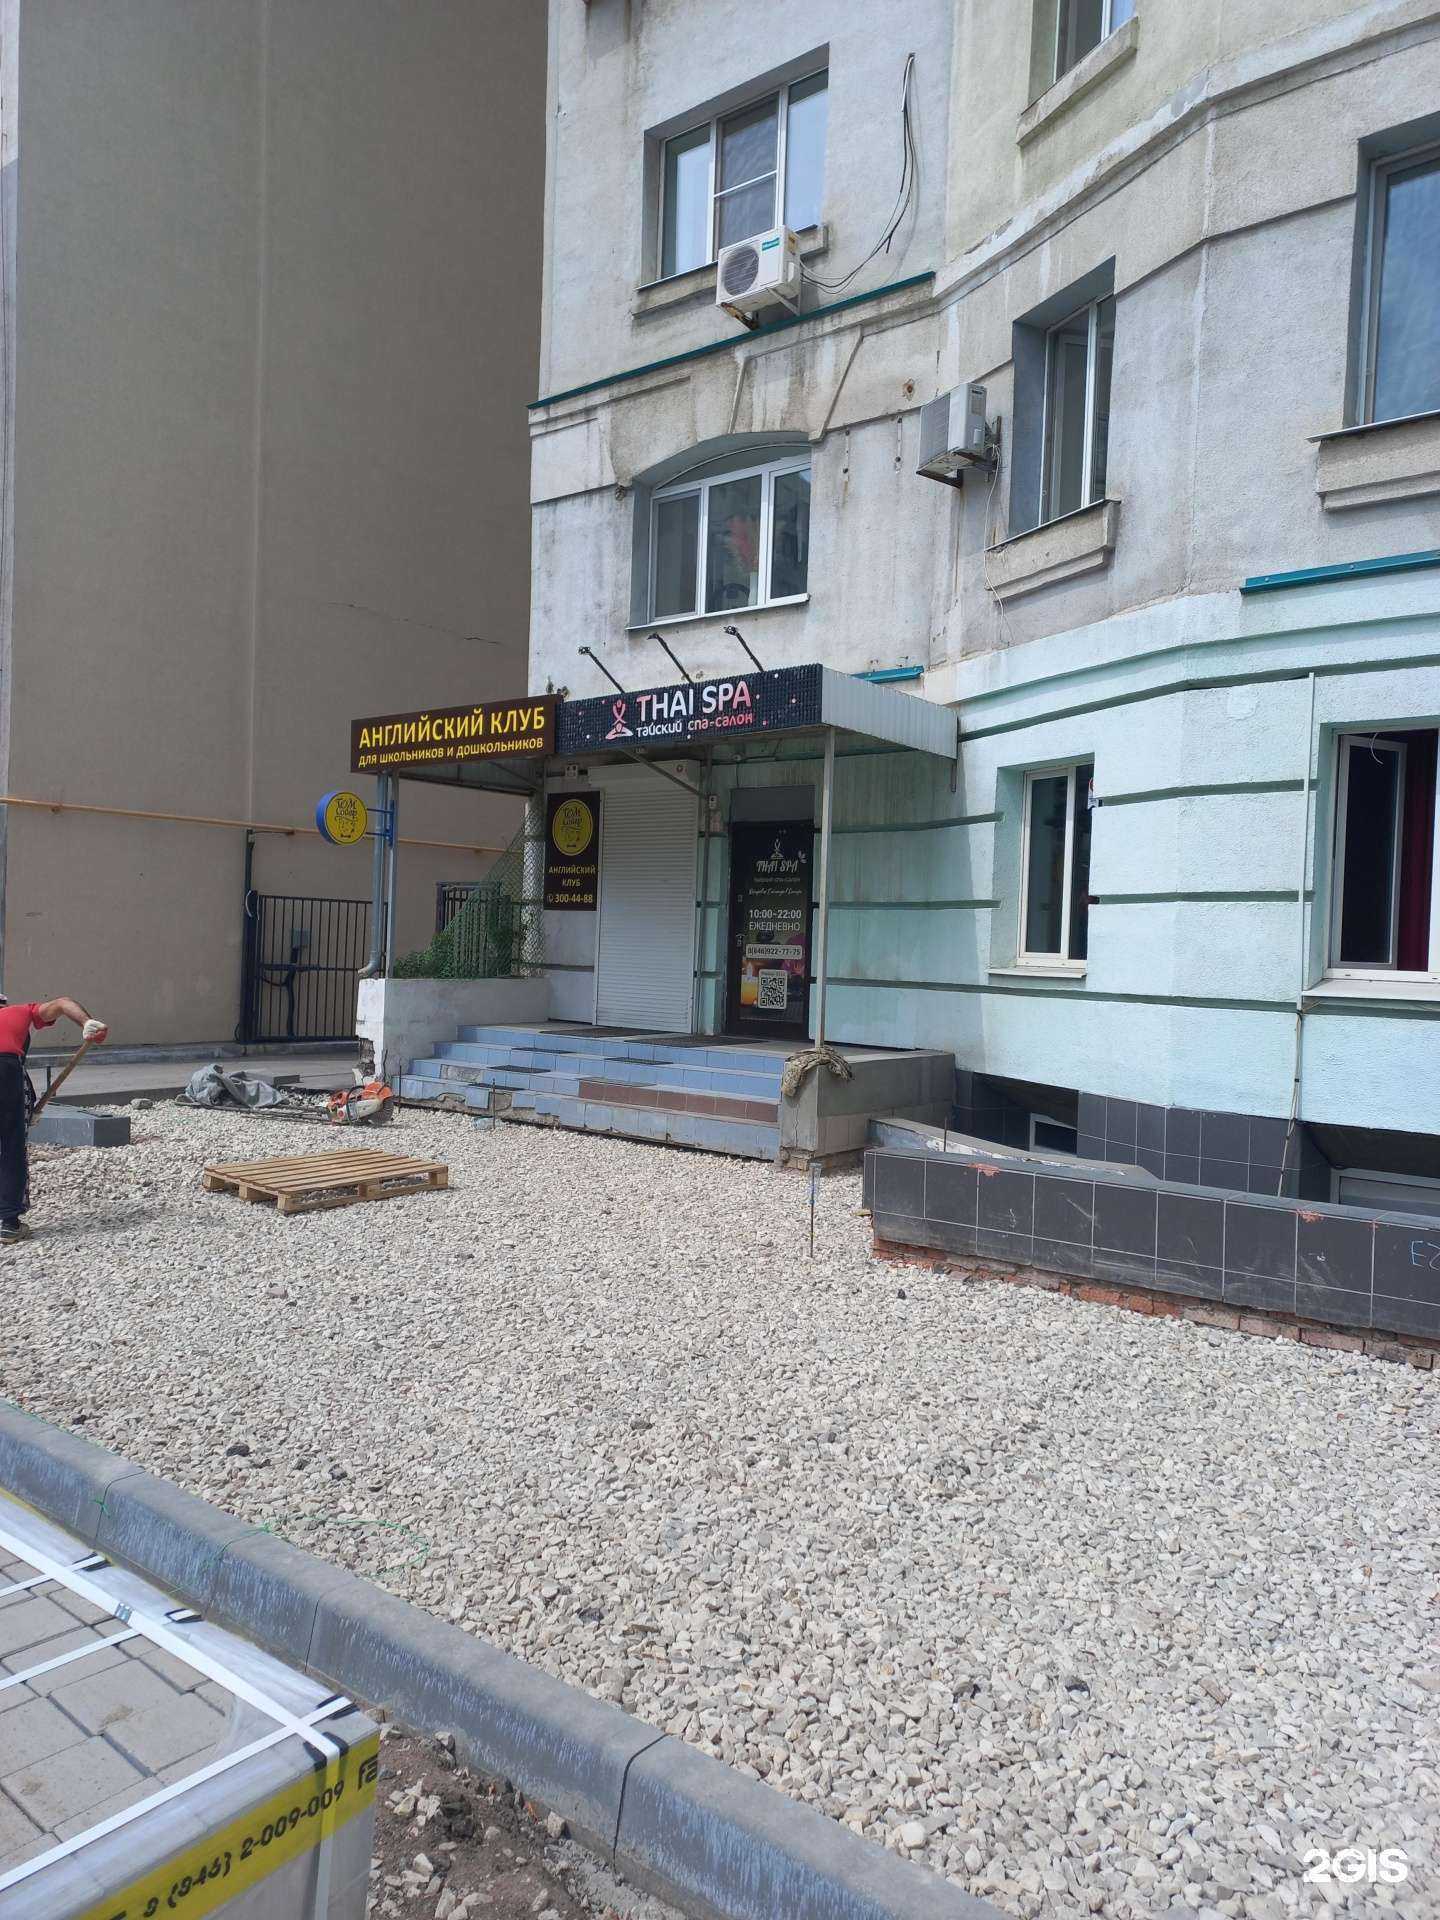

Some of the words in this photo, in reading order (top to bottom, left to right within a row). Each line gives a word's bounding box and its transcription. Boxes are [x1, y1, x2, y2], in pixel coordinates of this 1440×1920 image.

[637, 688, 694, 722] THAI
[702, 680, 752, 714] SPA
[359, 708, 484, 749] АНГЛИЙСКИЙ
[490, 706, 545, 734] КЛУБ
[687, 712, 753, 732] спа-салон
[548, 864, 597, 874] АНГЛИЙСКИЙ
[562, 878, 581, 887] КЛУБ
[749, 921, 801, 931] ЕЖЕДНЕВНО
[239, 1780, 345, 1861] 2-009-009
